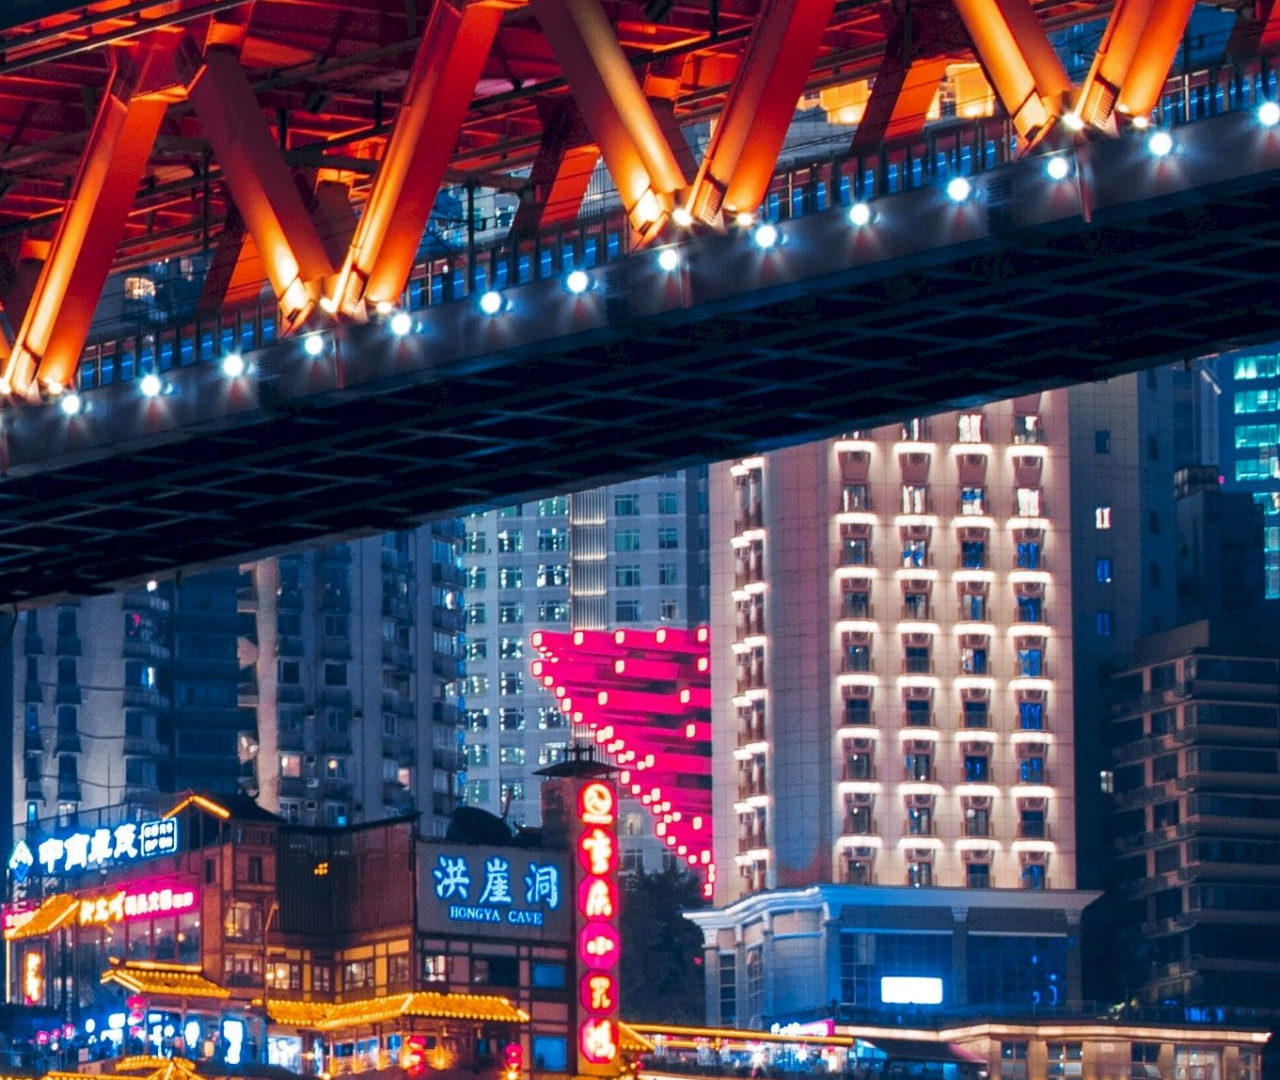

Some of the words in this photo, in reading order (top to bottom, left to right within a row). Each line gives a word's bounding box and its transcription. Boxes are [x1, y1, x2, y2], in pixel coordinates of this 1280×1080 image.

[433, 856, 559, 908] 洪崖洞
[450, 906, 501, 922] HONGYA
[508, 910, 543, 926] CAVE
